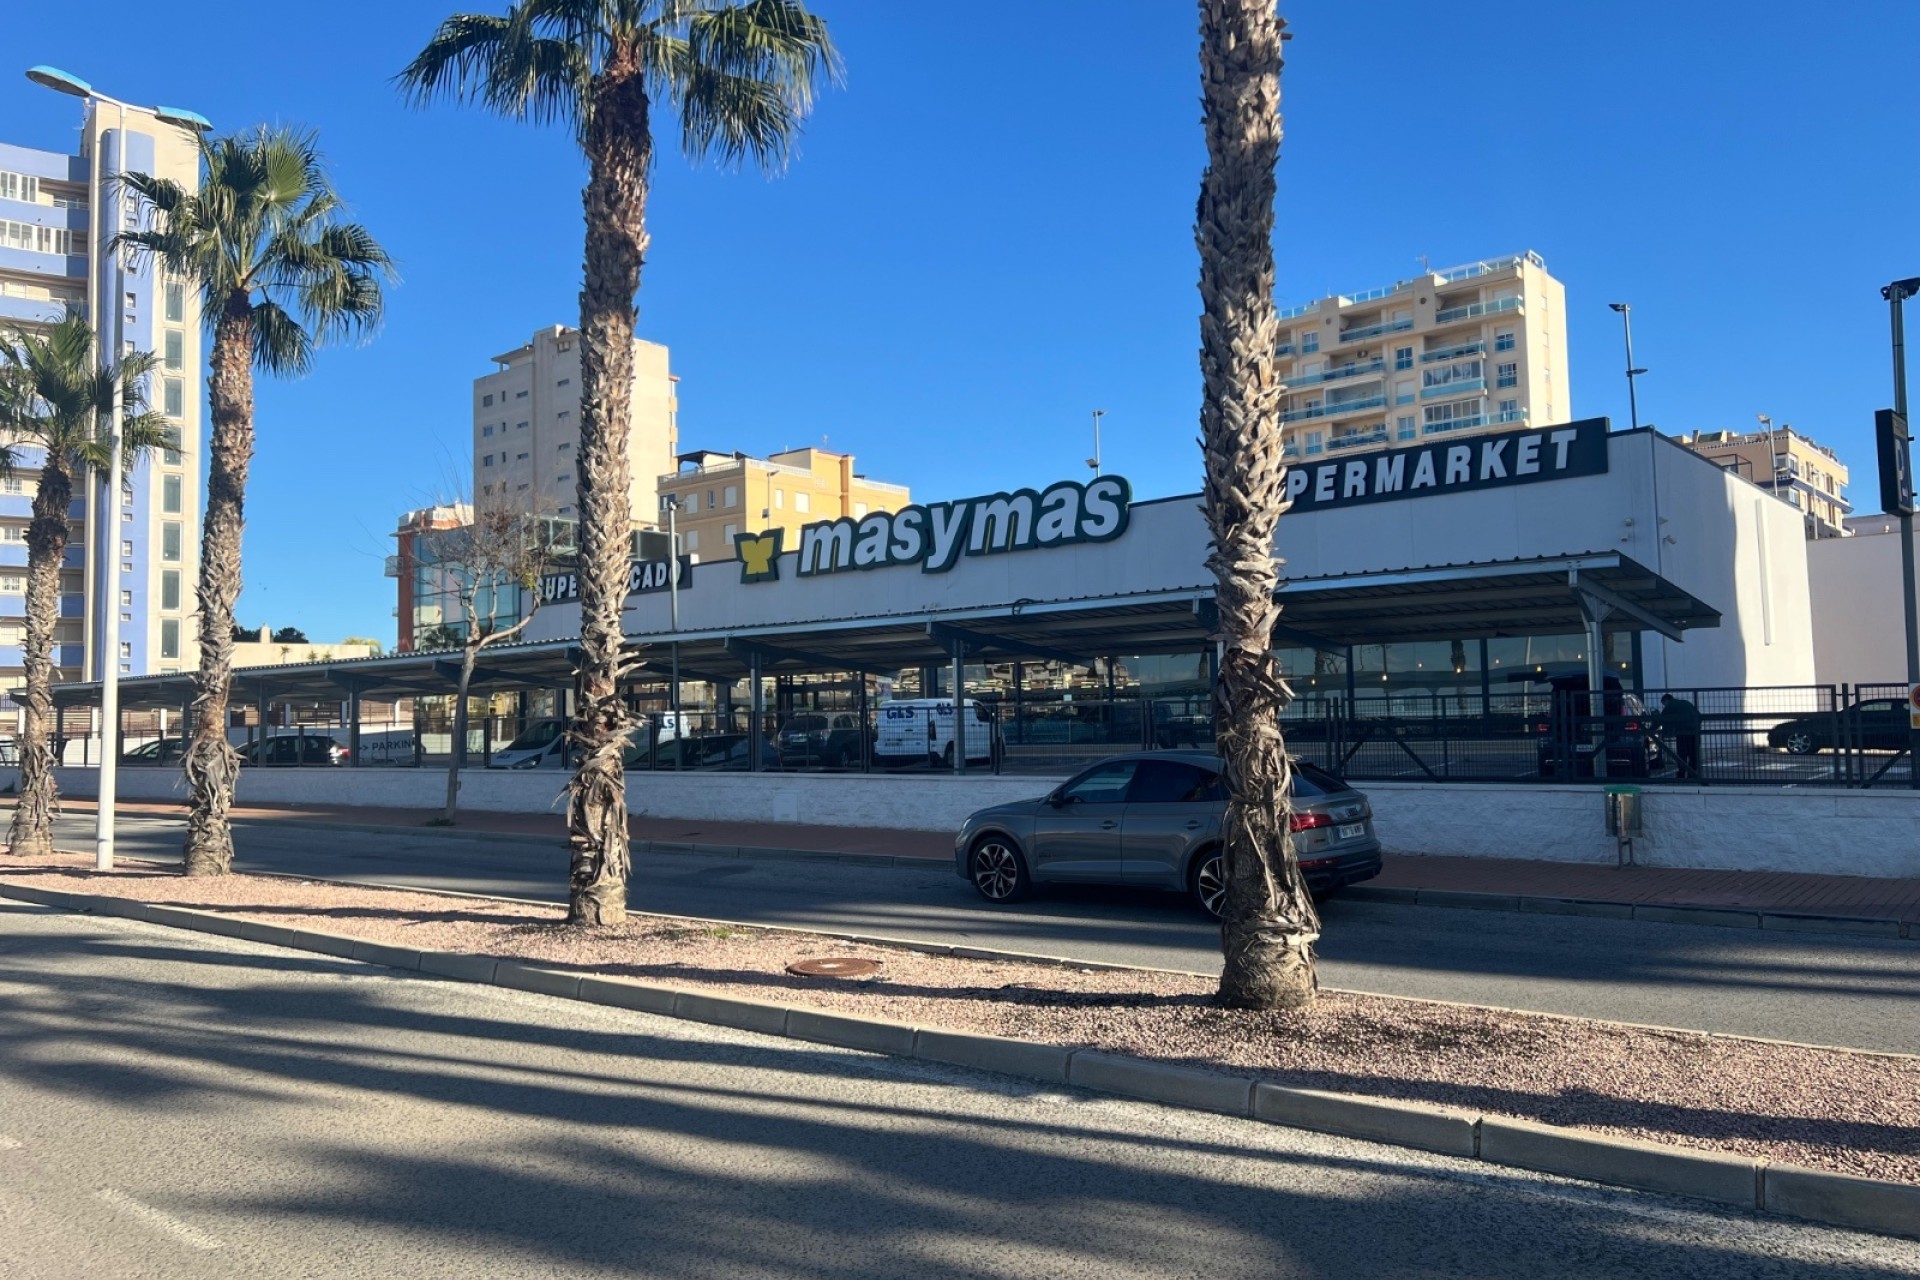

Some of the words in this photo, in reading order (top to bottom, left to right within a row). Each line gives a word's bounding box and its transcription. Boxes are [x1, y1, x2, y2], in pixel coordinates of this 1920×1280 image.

[800, 481, 1122, 569] masymas
[535, 560, 682, 600] SUPECADO
[887, 706, 914, 719] GLS
[372, 740, 415, 751] PARKIN
